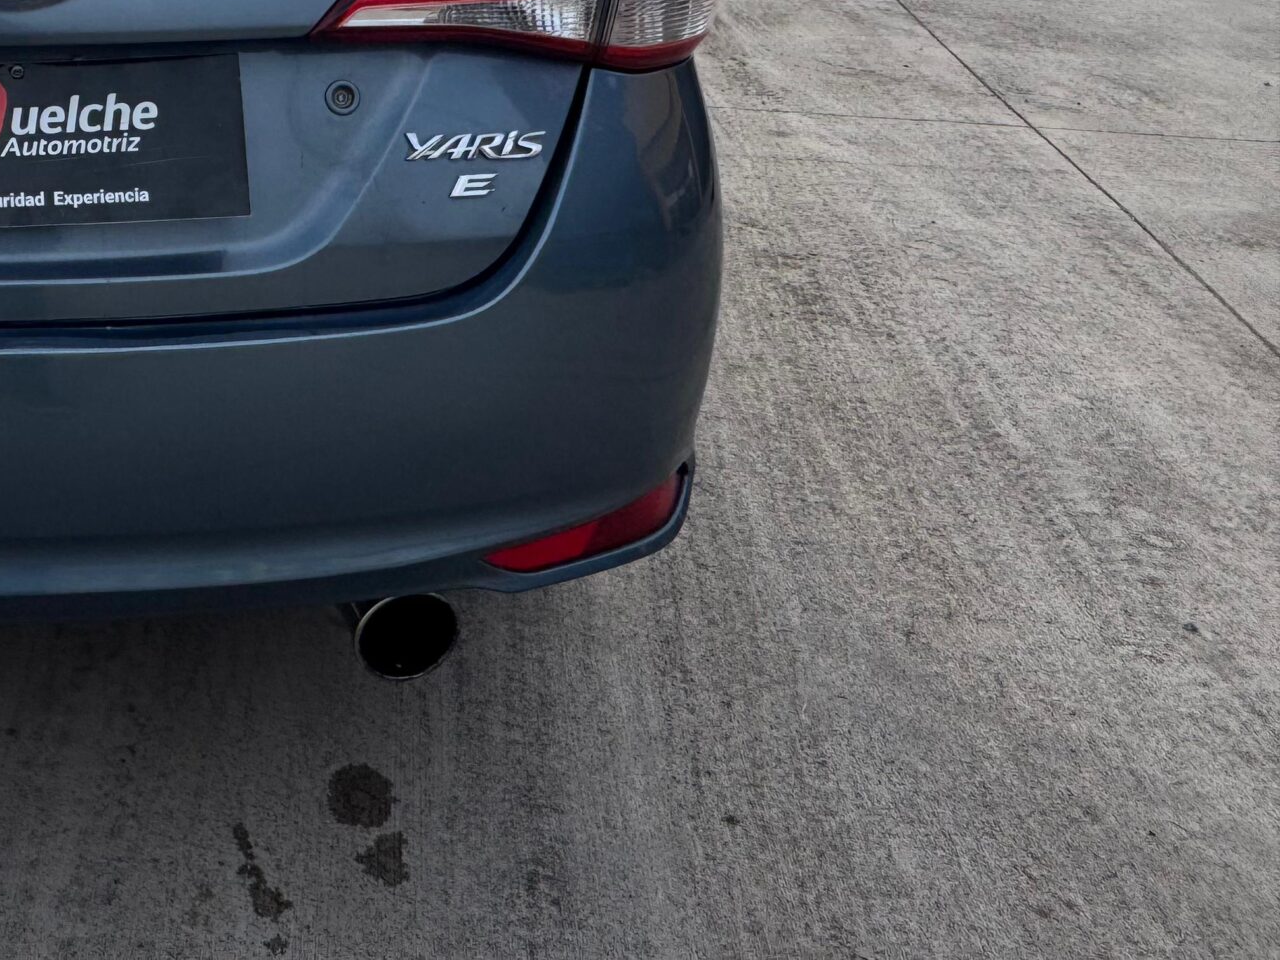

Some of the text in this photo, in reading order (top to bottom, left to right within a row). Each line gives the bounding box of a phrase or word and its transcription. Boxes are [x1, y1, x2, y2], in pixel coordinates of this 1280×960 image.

[0, 132, 141, 157] Automotriz
[405, 129, 547, 161] YARIS
[53, 187, 150, 208] Experiencia
[449, 172, 499, 198] E
